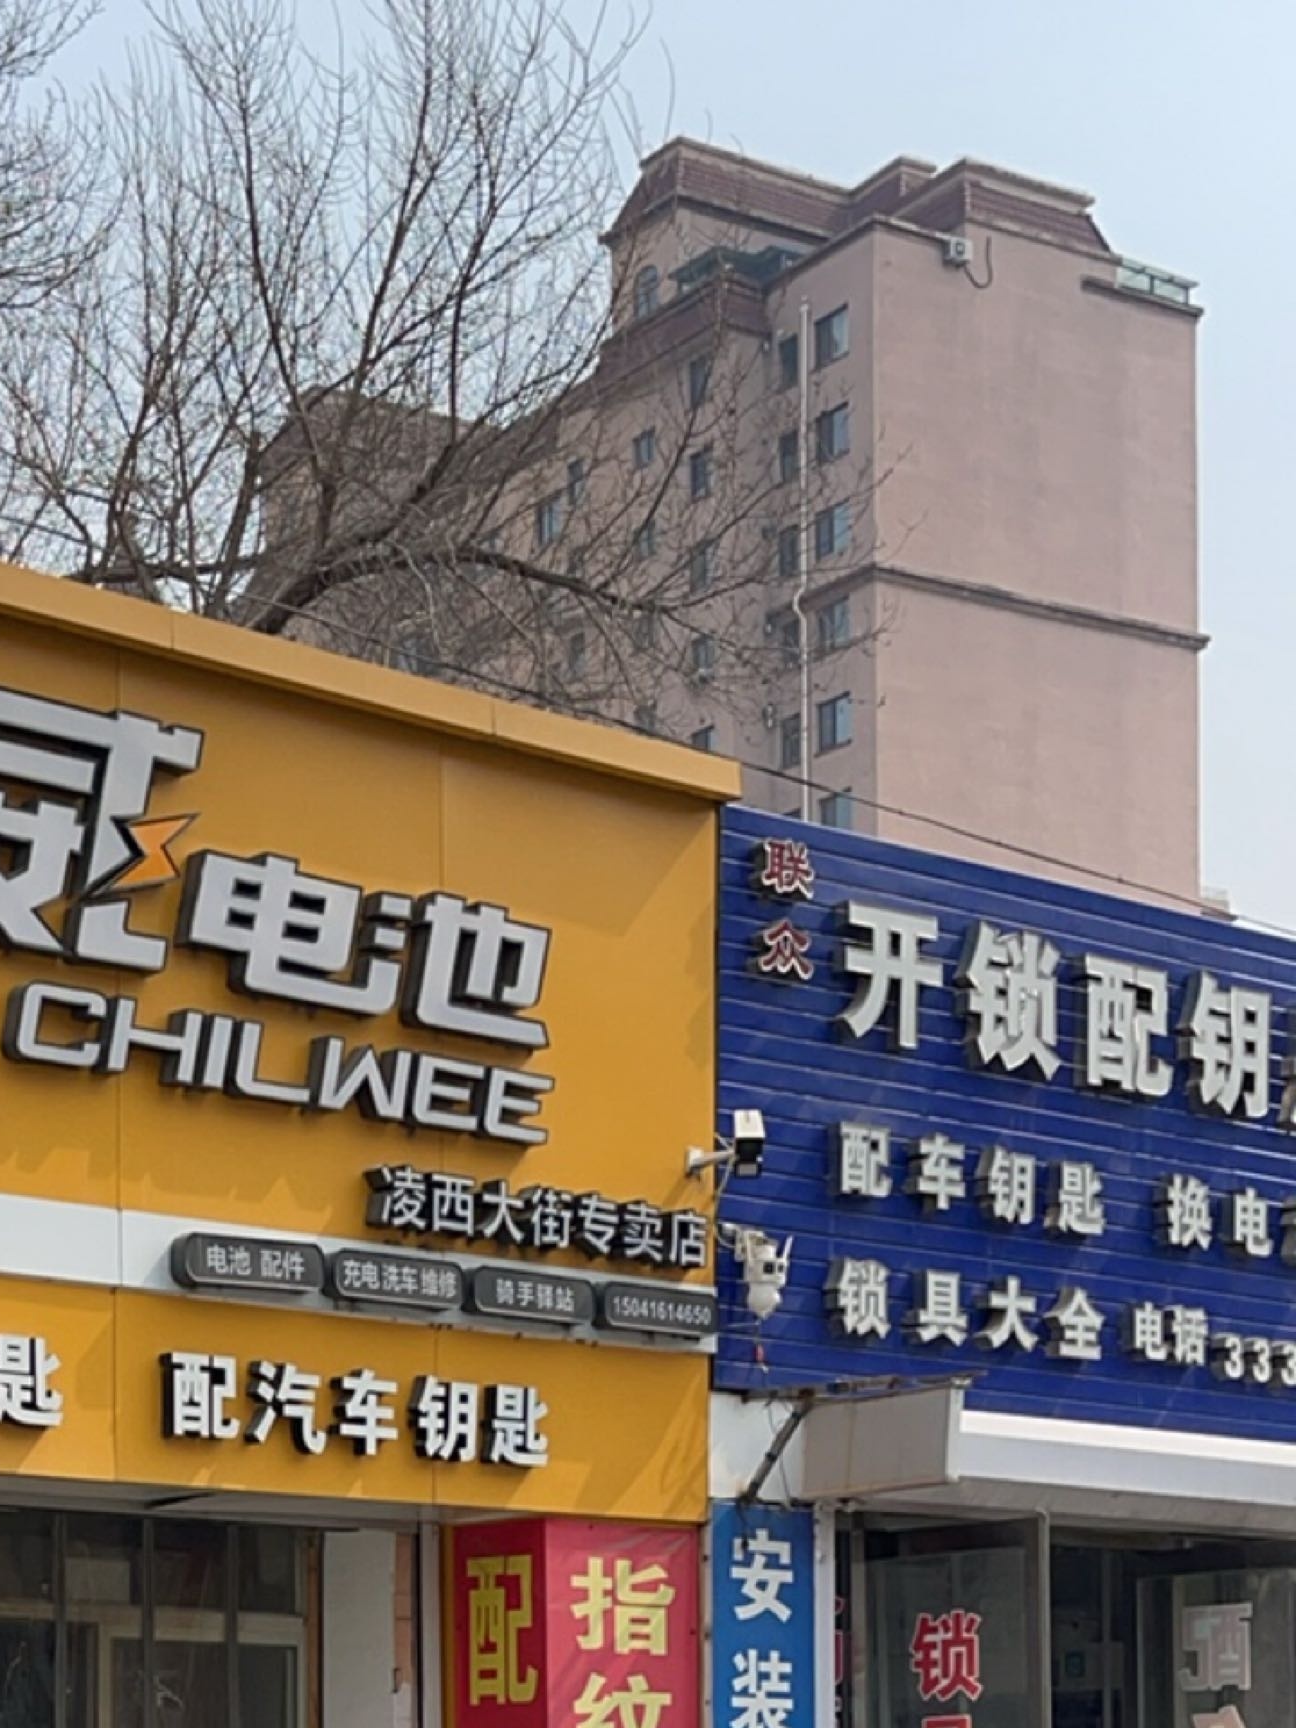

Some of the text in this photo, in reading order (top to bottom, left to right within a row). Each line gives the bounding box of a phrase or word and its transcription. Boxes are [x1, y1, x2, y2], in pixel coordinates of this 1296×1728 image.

[4, 979, 554, 1146] CHILWEE
[837, 900, 1296, 1135] 开锁配钥
[372, 1165, 708, 1268] 凌西大街专卖店
[833, 1121, 1296, 1262] 配车钥匙 换电
[832, 1256, 1104, 1361] 锁具大全
[162, 1350, 549, 1468] 配汽车钥匙
